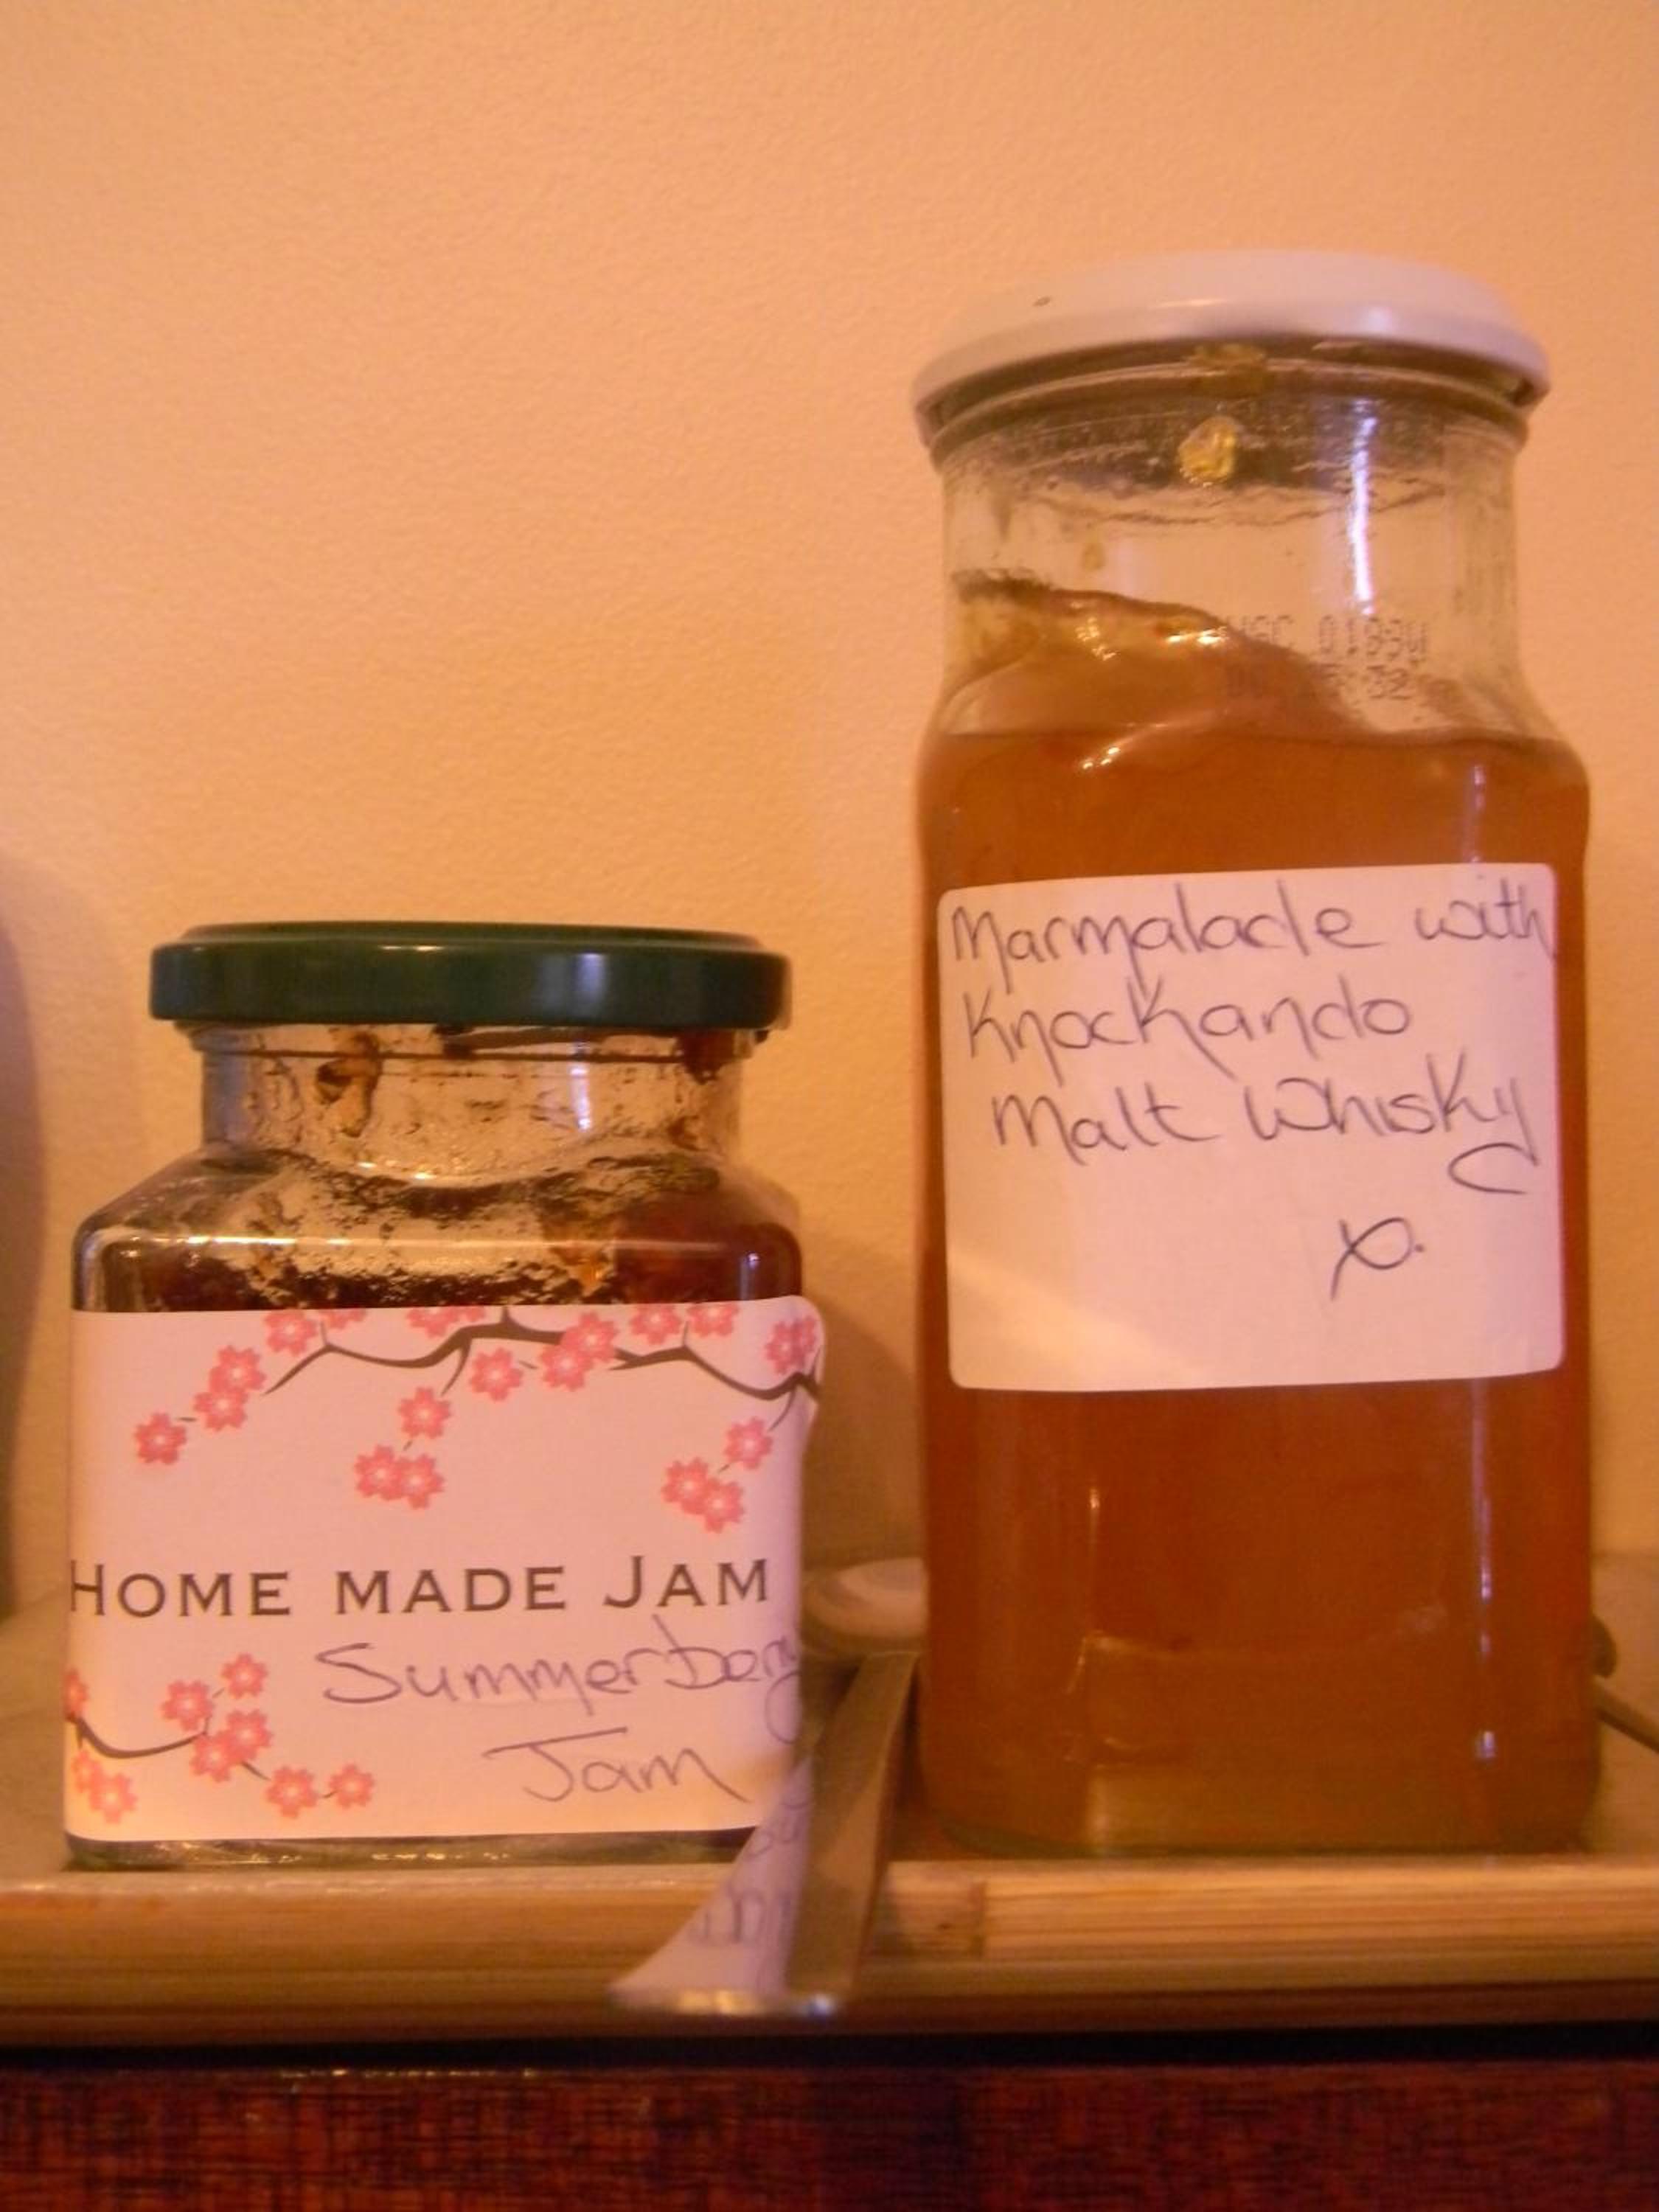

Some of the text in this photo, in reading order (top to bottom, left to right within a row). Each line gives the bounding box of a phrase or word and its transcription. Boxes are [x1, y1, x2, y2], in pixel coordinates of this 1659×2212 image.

[952, 877, 1556, 995] Marmalade with
[992, 1045, 1541, 1195] Malt Whisky
[335, 1565, 566, 1615] MADE
[482, 1726, 754, 1804] Jam
